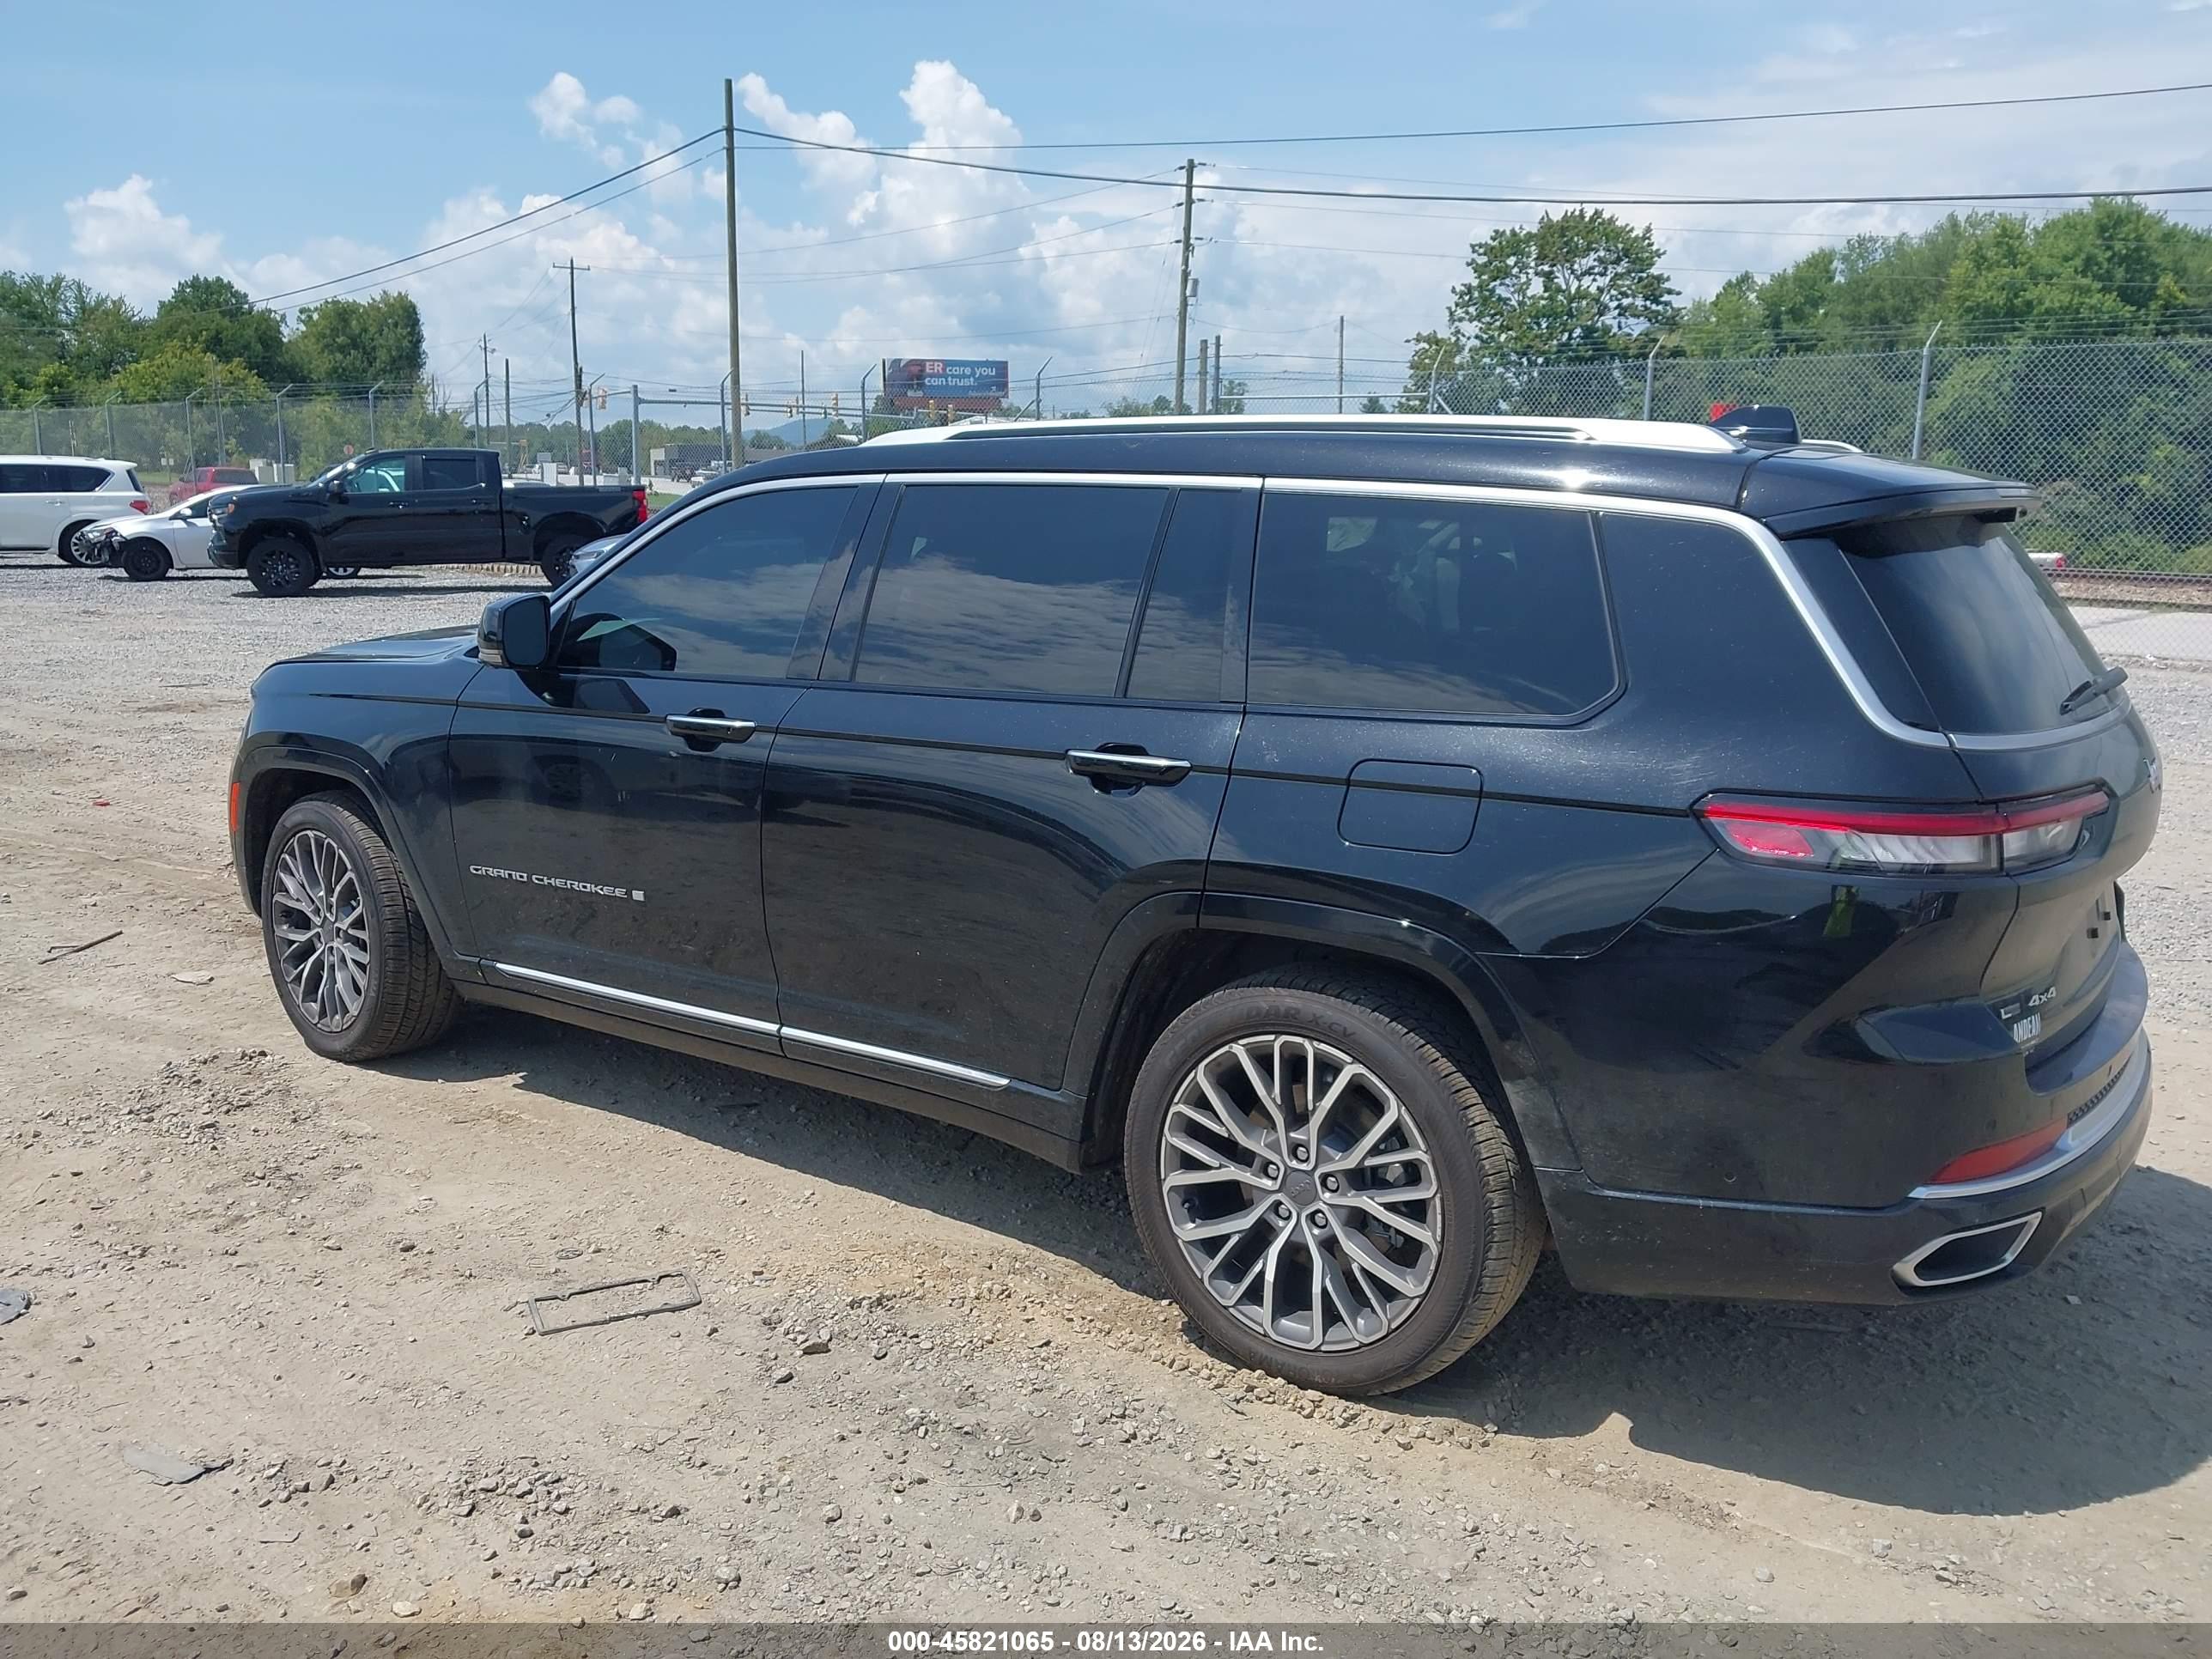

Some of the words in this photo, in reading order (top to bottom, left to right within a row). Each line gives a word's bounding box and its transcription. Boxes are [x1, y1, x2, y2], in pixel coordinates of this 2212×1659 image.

[925, 362, 943, 374] ER
[945, 366, 971, 375] care
[974, 366, 996, 378] you
[924, 376, 946, 386] can
[947, 376, 978, 386] trust.
[469, 865, 527, 883] GRAND
[532, 874, 629, 898] CHEROKEE
[2027, 986, 2057, 1007] 4x4
